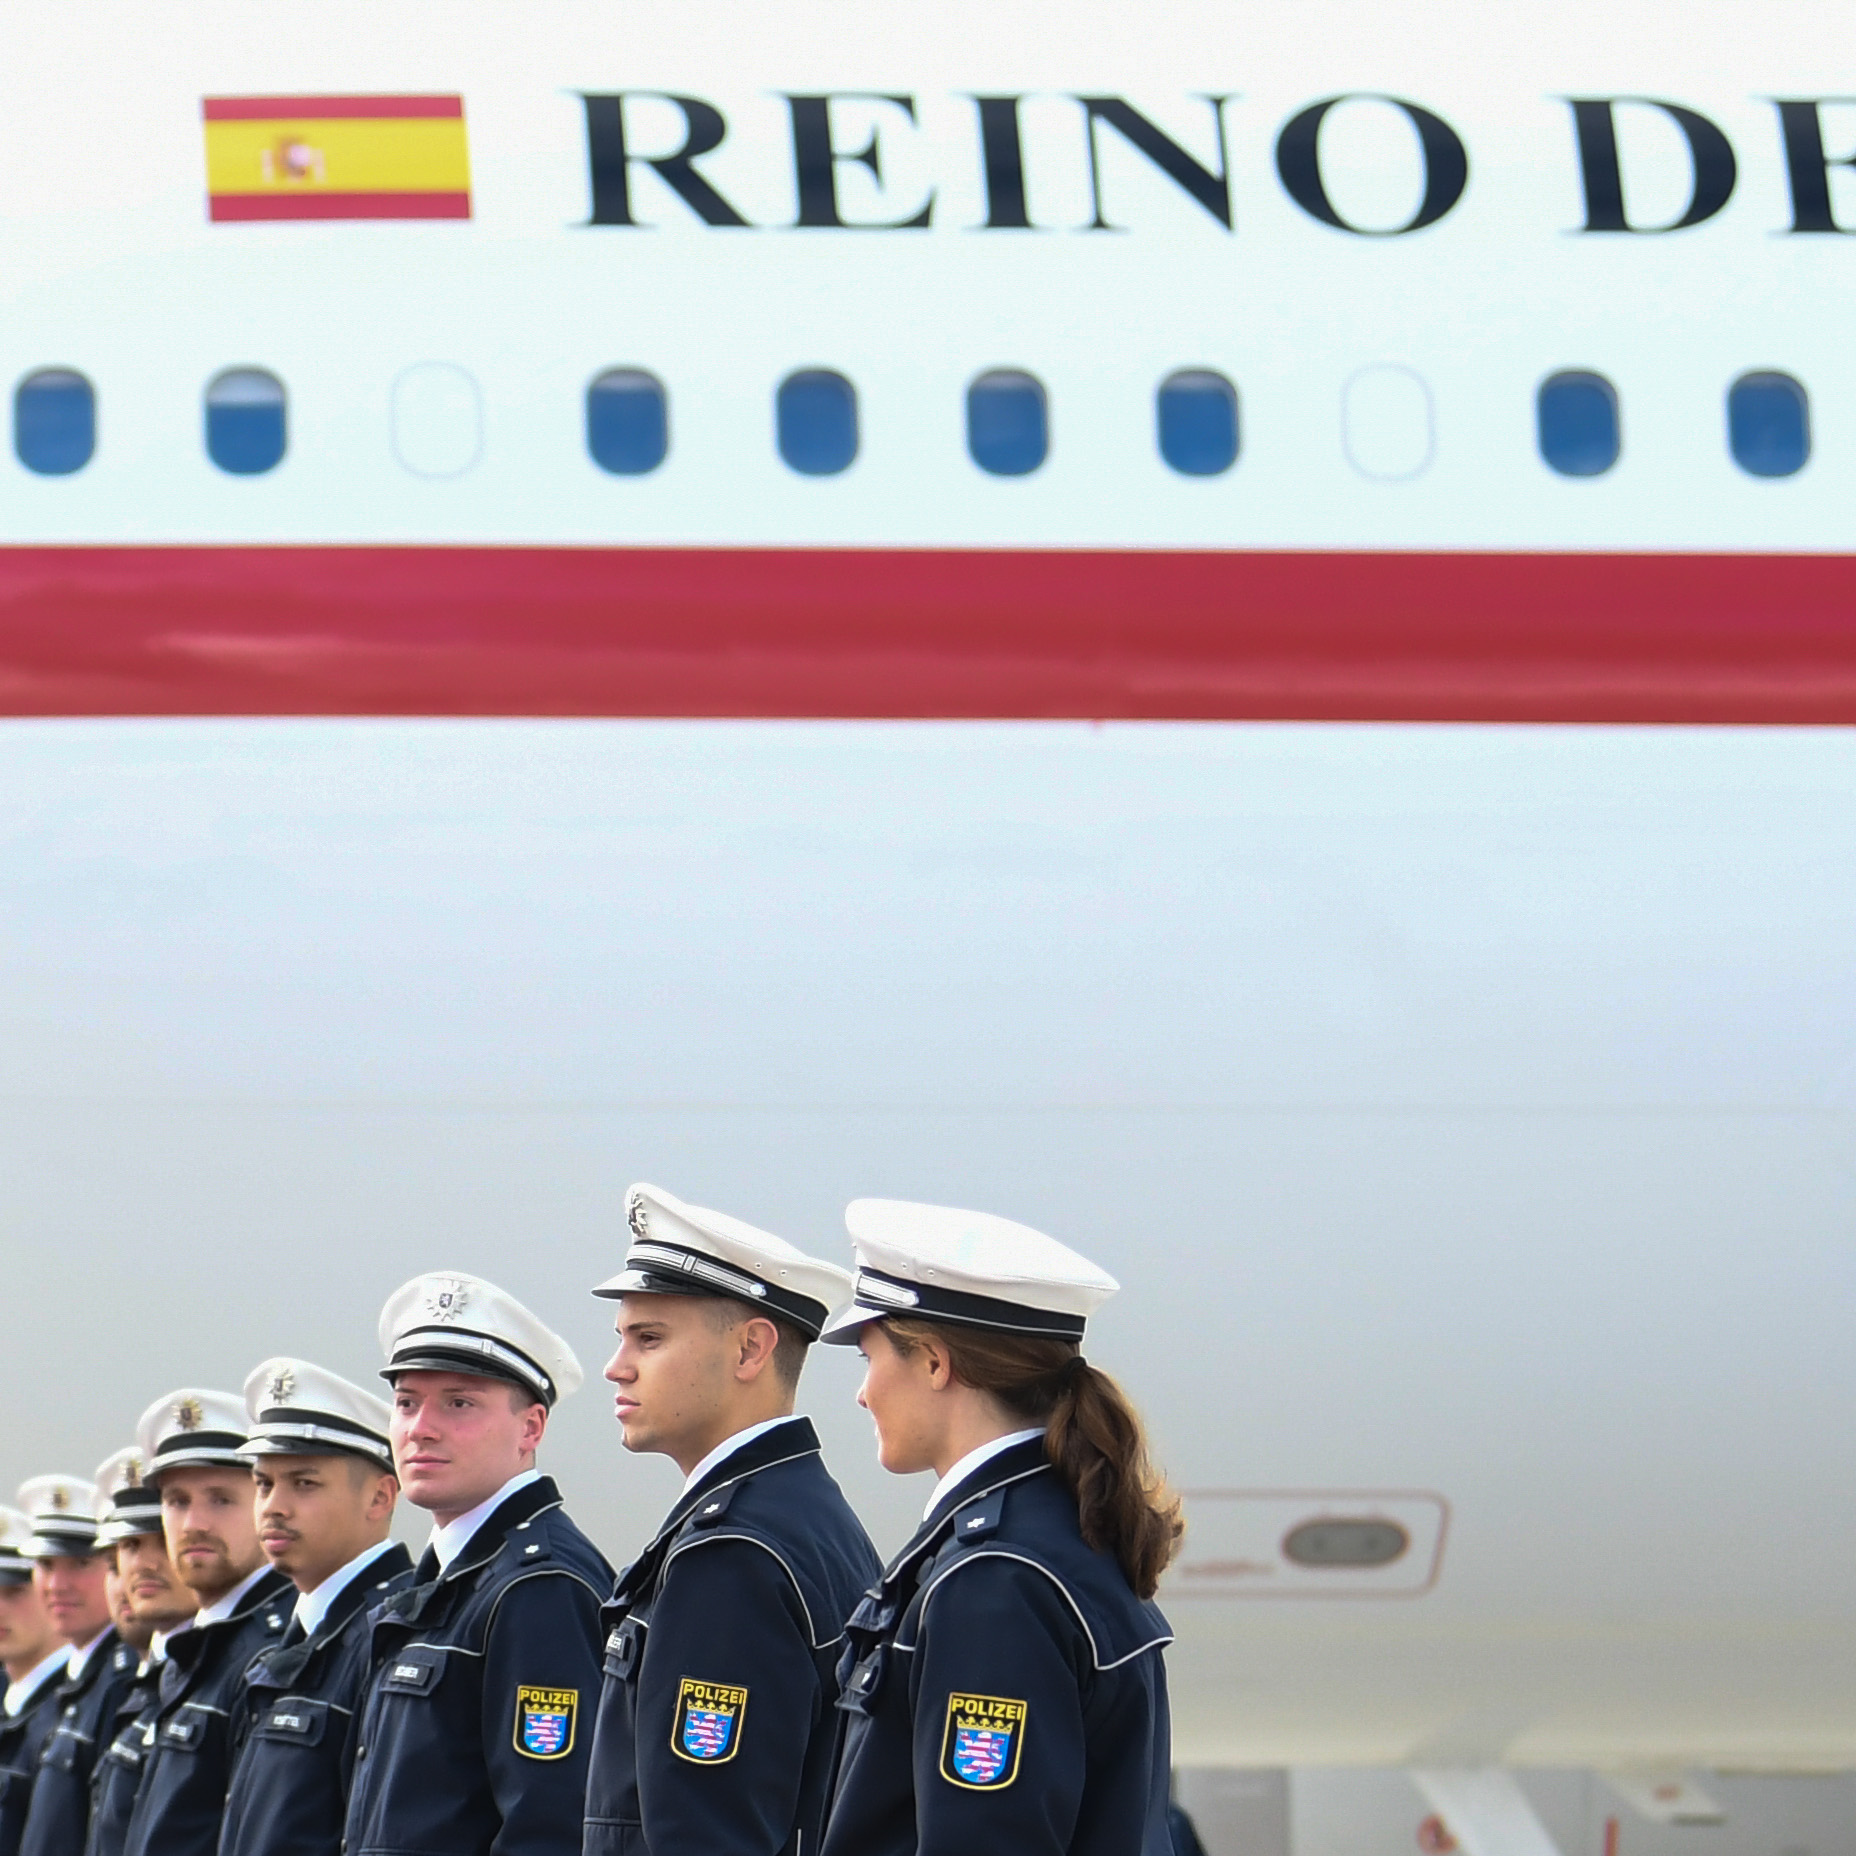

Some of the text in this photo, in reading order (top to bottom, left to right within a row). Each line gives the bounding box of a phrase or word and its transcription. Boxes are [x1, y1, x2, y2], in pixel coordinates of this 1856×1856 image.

[564, 89, 1856, 238] REINO DE
[519, 1689, 575, 1705] POLIZEI
[682, 1682, 744, 1705] POLIZEI
[951, 1698, 1023, 1721] POLIZEI
